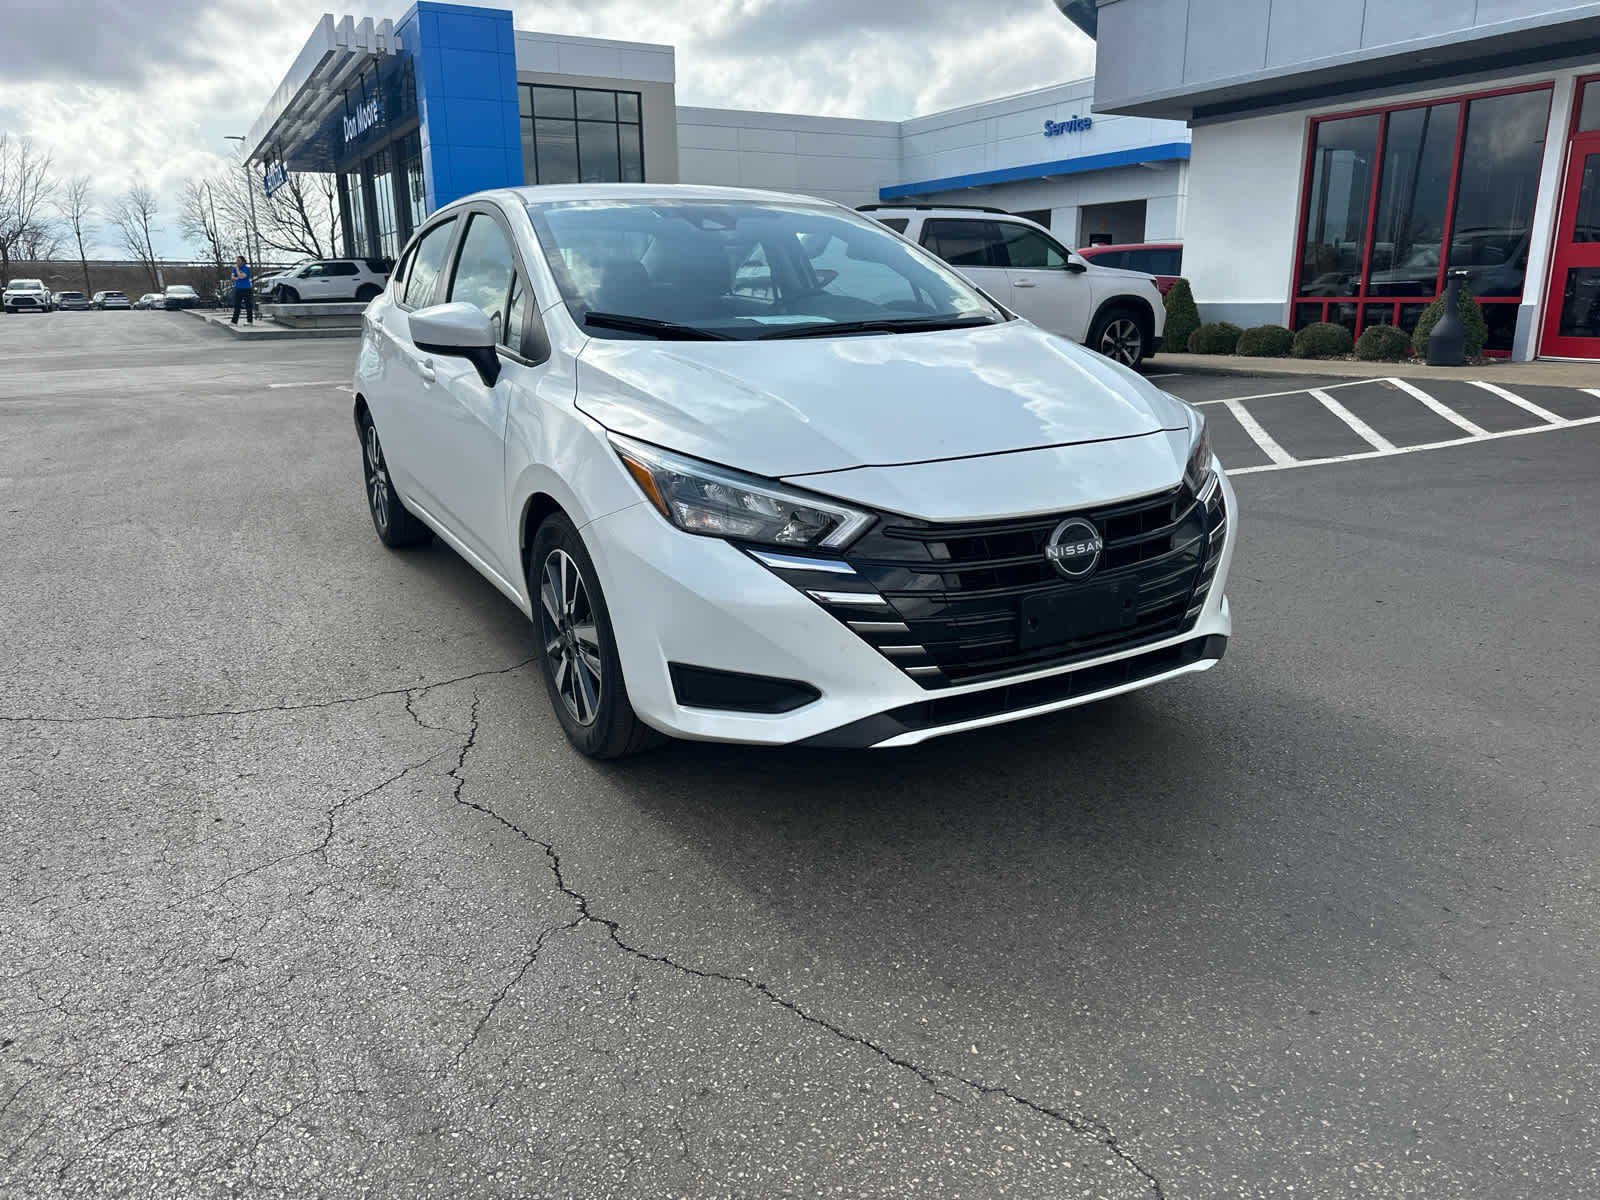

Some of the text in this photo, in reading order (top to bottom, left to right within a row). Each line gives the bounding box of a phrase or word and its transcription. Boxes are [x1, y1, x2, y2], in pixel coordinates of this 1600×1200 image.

[343, 100, 378, 143] Don Moore
[1043, 114, 1093, 136] Service
[1047, 540, 1103, 558] NISSAN
